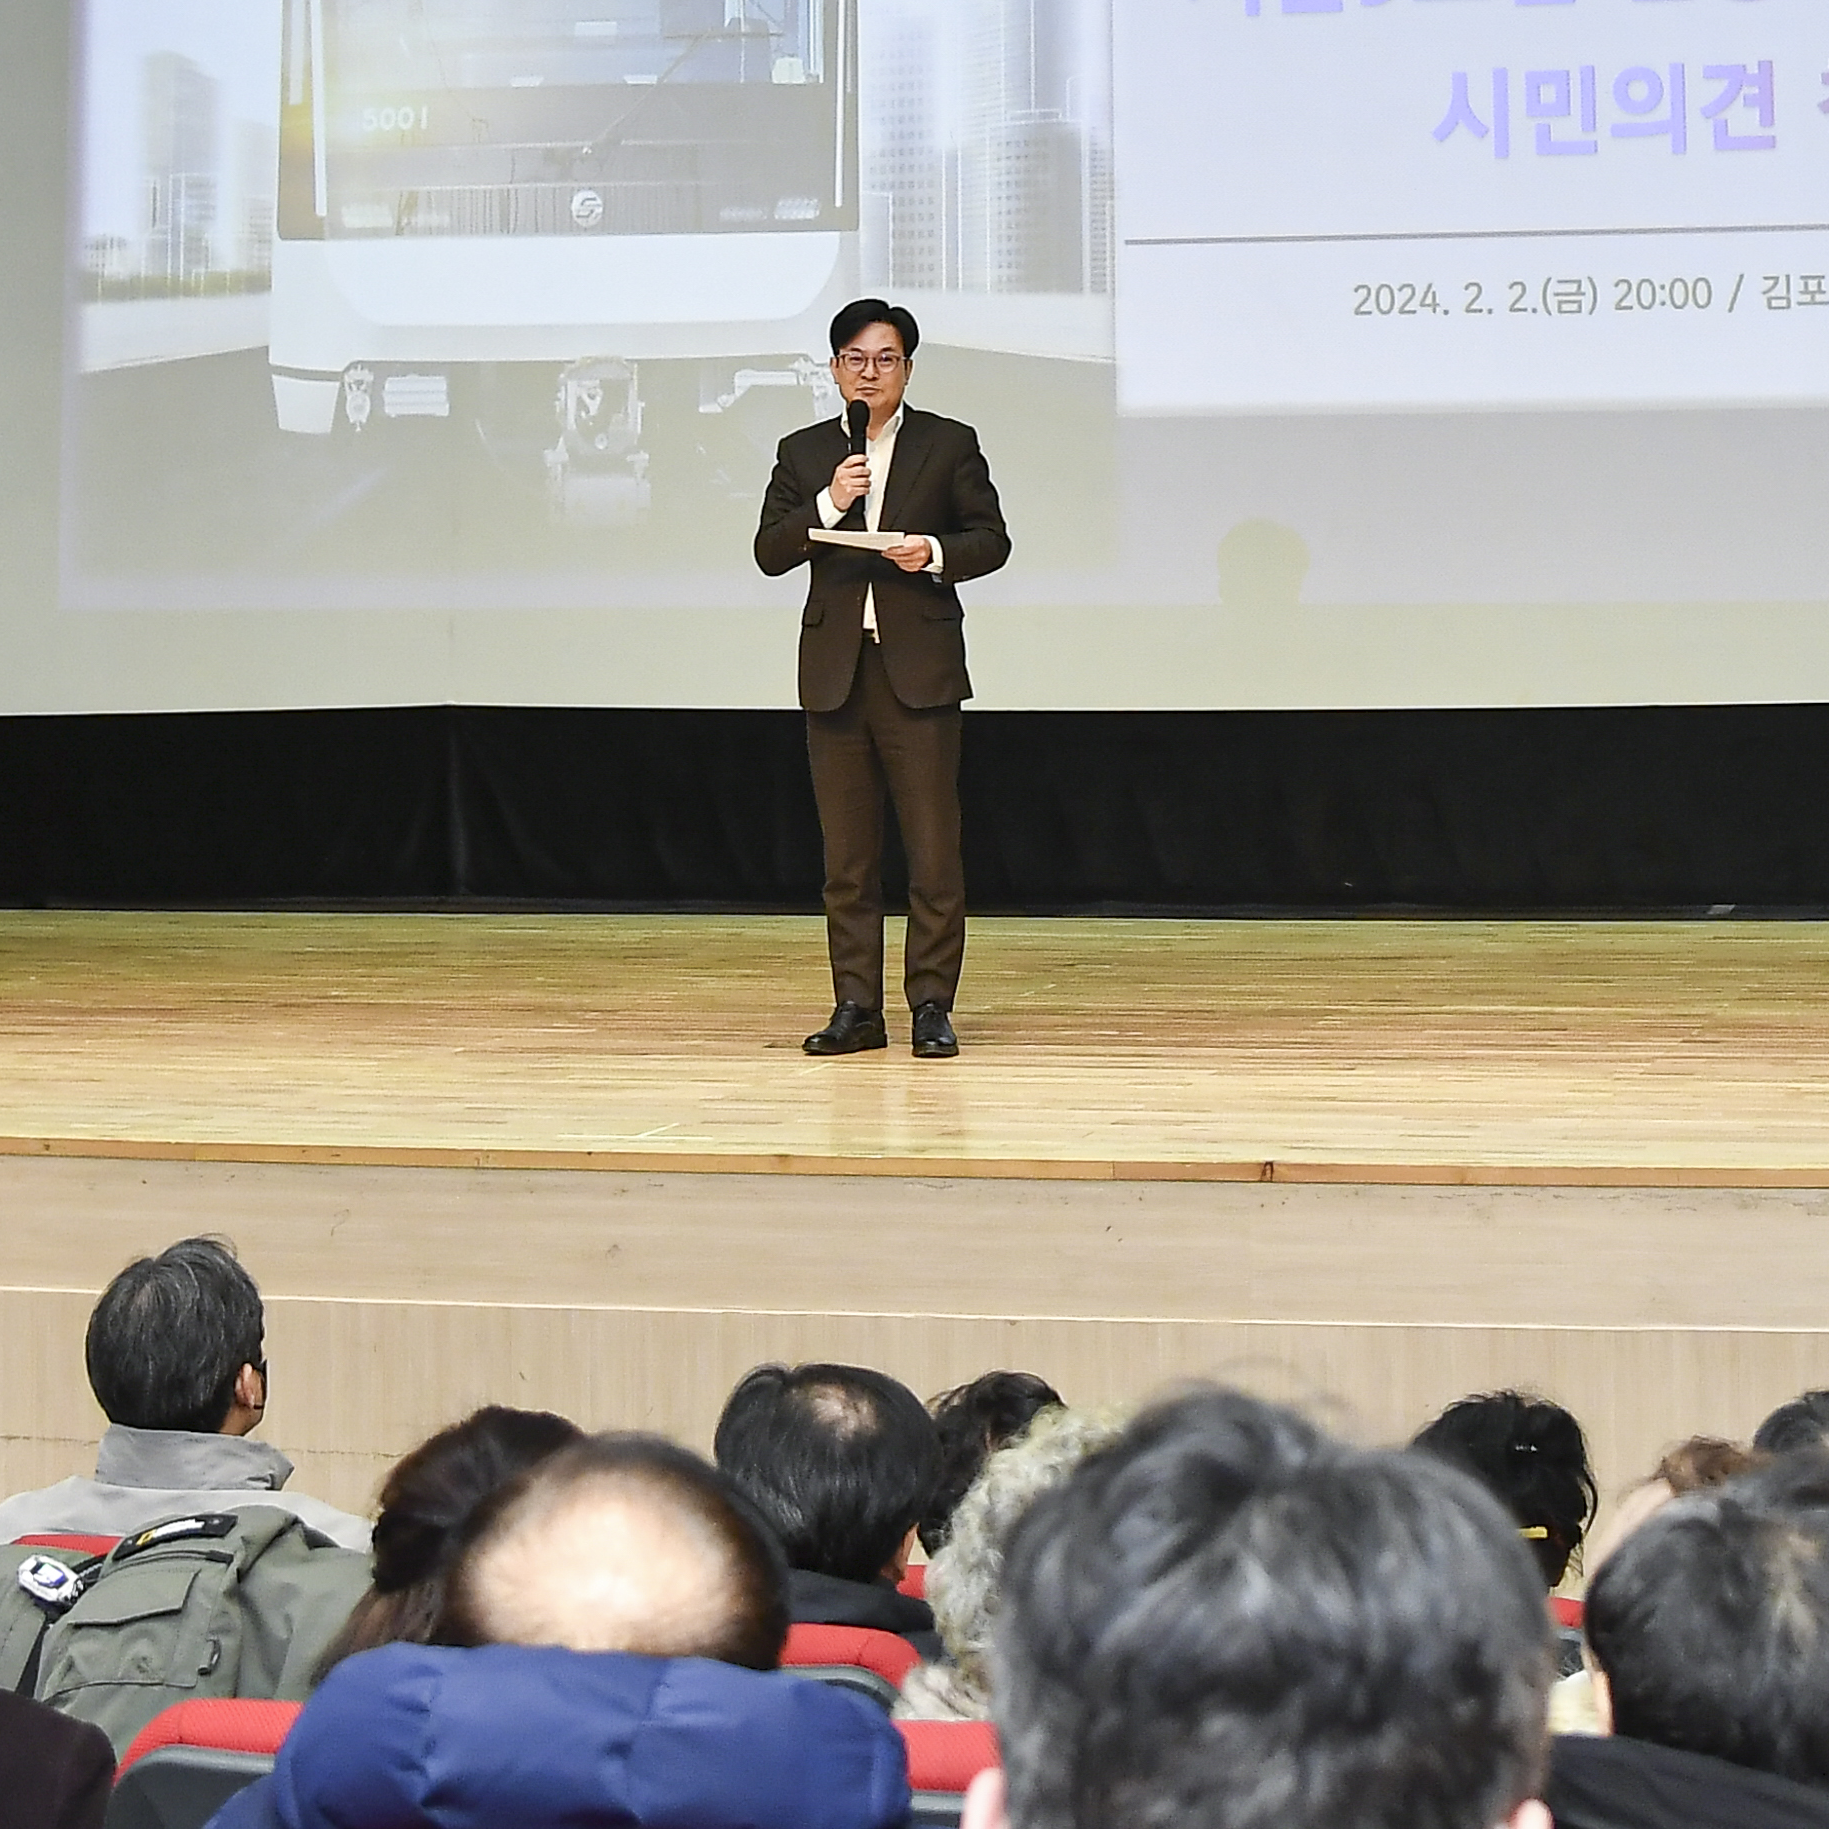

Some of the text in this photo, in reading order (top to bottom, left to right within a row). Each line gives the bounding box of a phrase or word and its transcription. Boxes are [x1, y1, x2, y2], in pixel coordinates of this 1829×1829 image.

[1430, 57, 1779, 159] 시민의견
[1352, 282, 1452, 318] 2024.
[1613, 275, 1713, 313] 20:00
